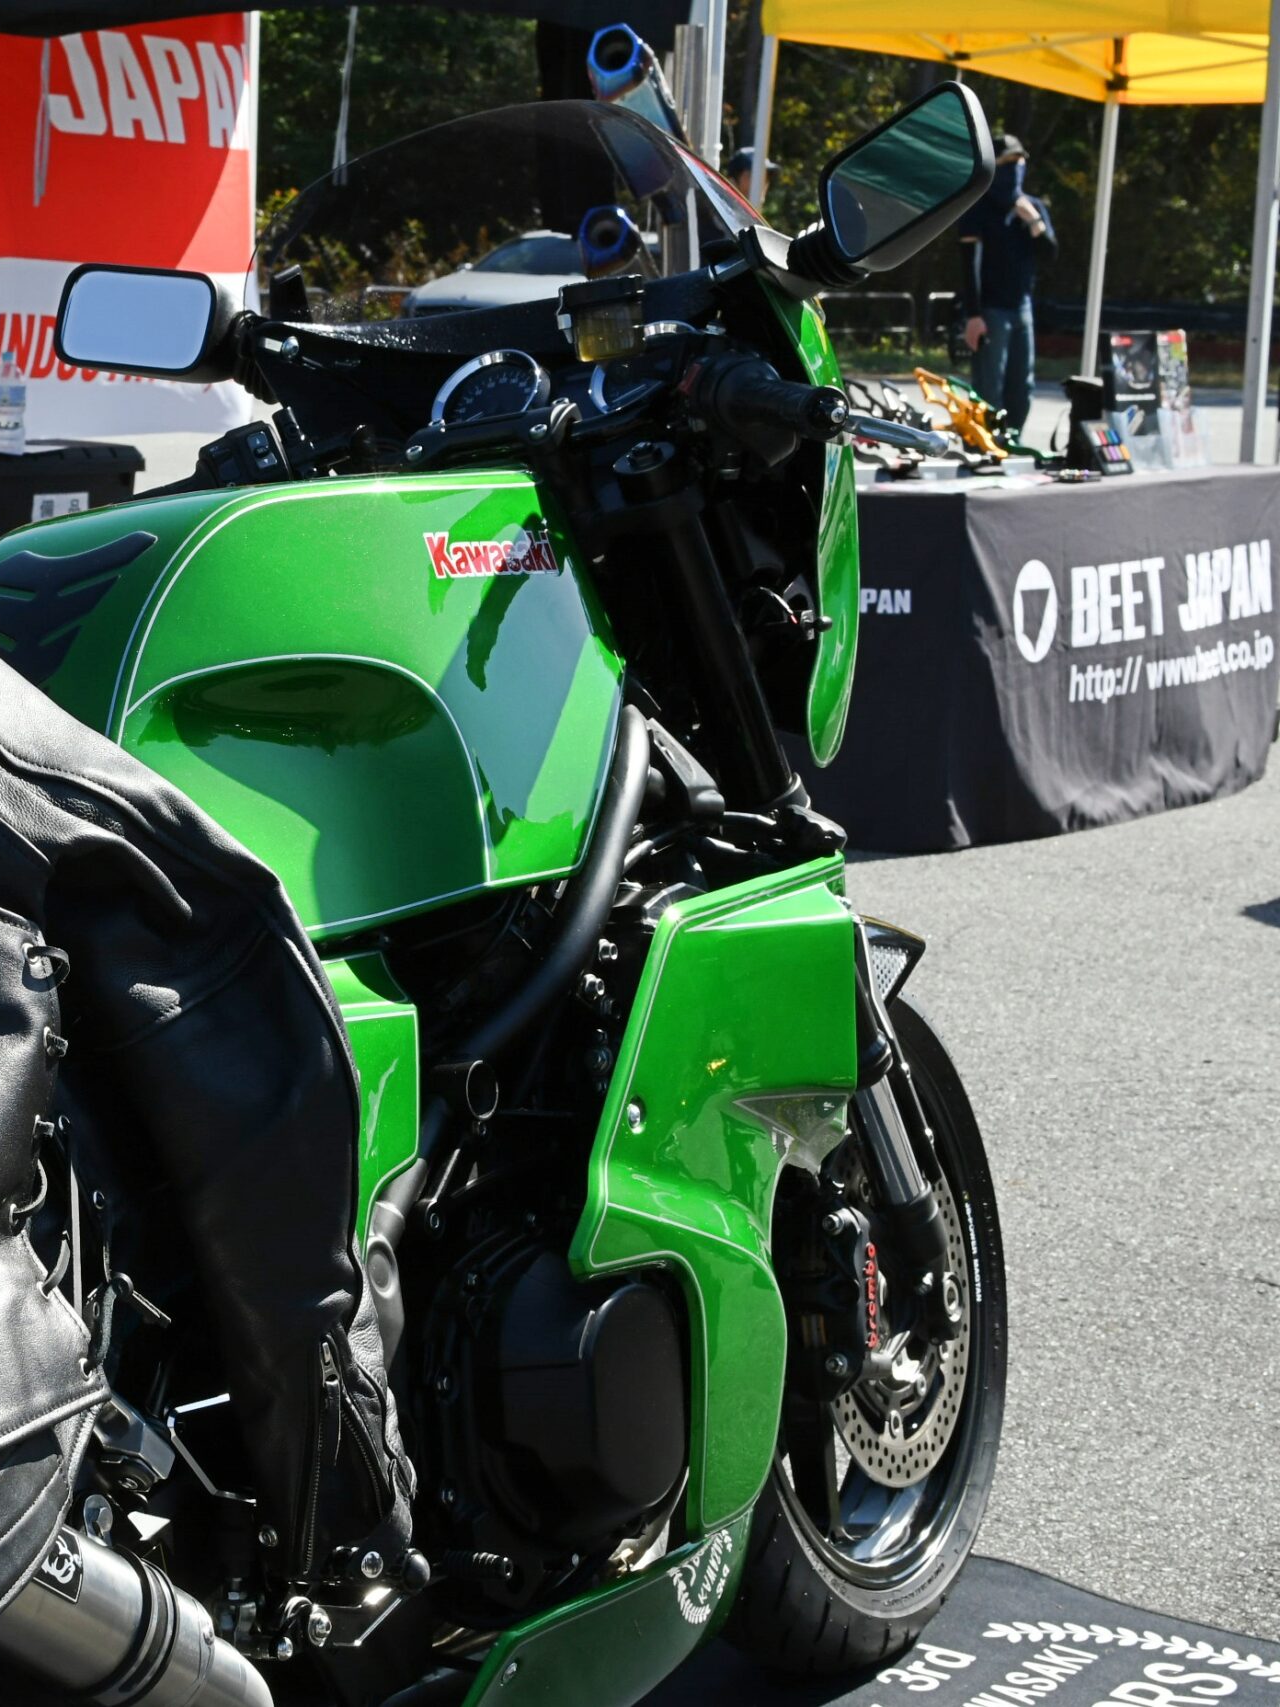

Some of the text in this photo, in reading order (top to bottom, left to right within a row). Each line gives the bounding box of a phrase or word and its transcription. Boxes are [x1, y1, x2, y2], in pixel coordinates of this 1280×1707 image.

[423, 531, 559, 579] Kawasaki
[859, 588, 911, 614] PAN
[1071, 539, 1273, 648] BEET JAPAN
[876, 1643, 977, 1692] 3rd
[962, 1644, 1099, 1707] WASAKI
